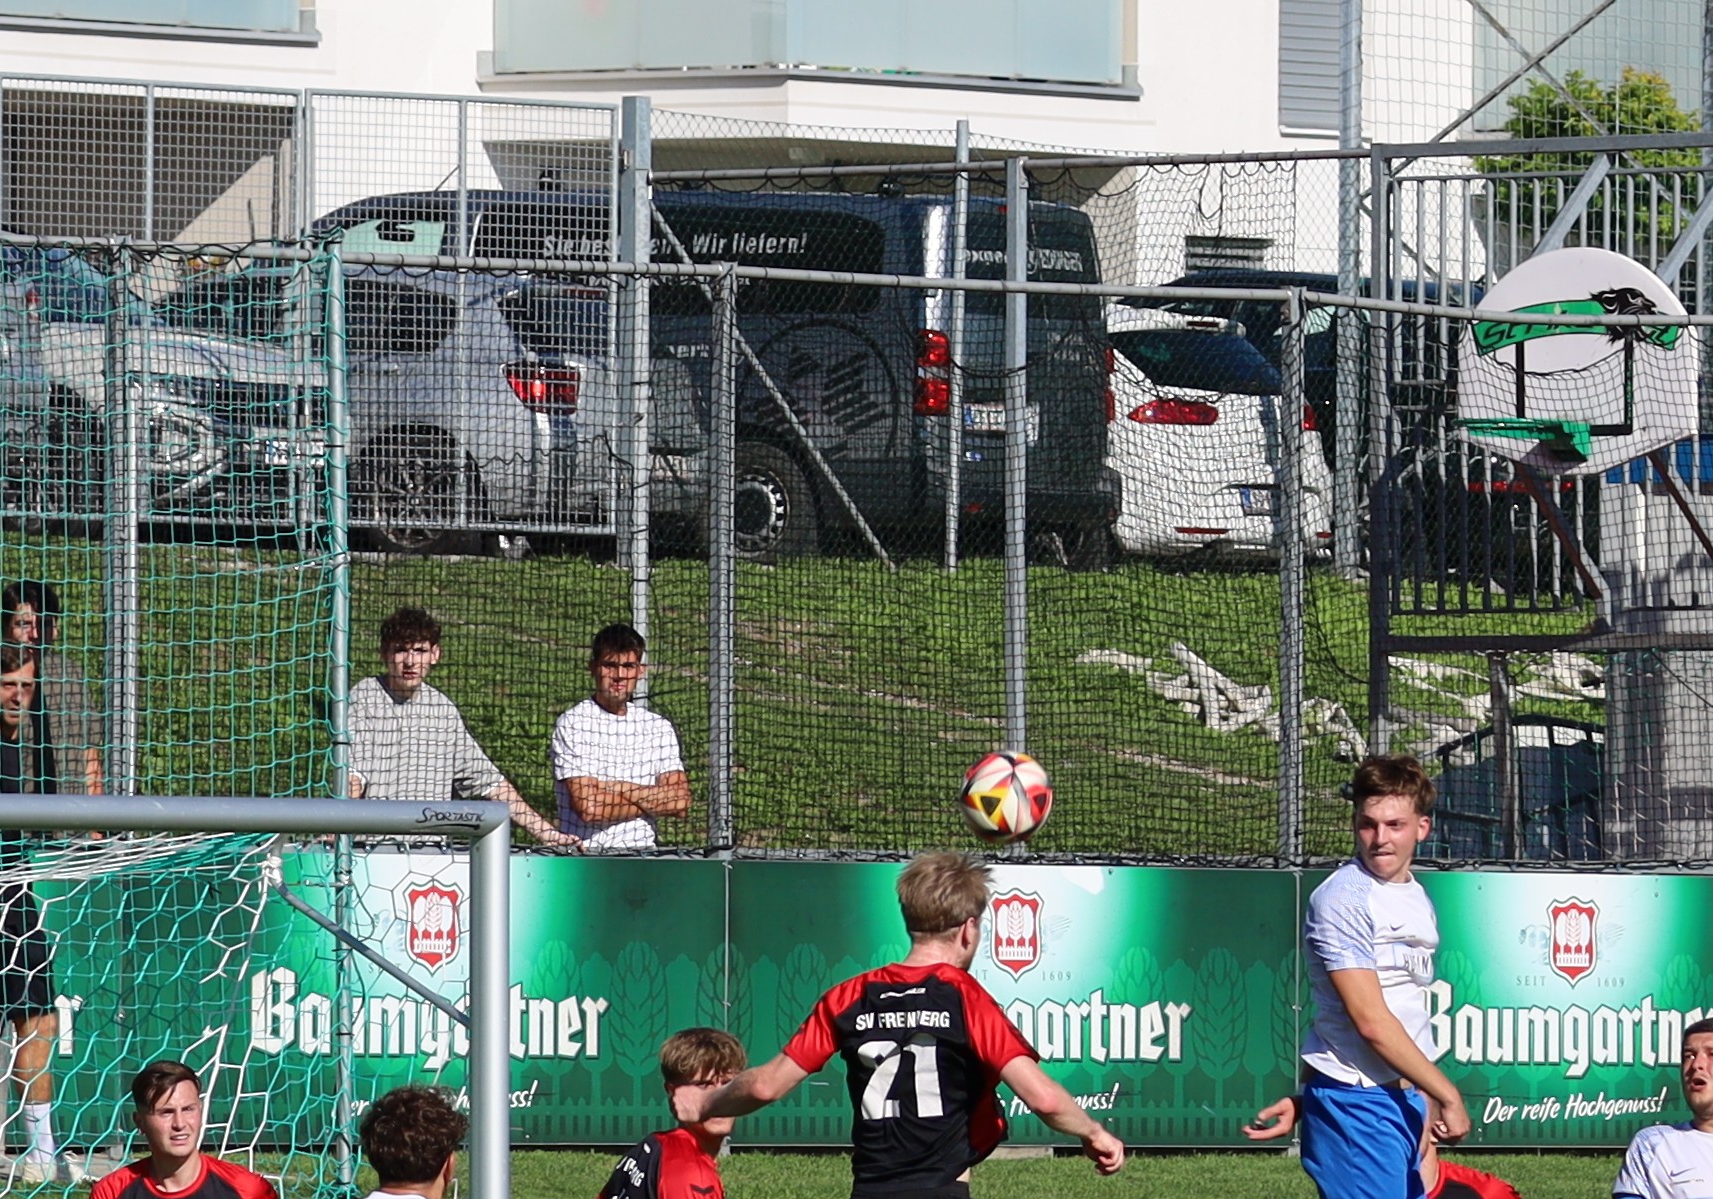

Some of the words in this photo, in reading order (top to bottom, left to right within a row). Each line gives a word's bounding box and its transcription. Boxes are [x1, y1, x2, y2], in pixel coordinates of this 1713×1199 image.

[692, 233, 726, 255] Wir
[1041, 970, 1072, 982] 1609
[1516, 975, 1546, 987] SEIT
[1597, 976, 1625, 988] 1609
[250, 966, 608, 1071] Baumgtner
[855, 1012, 875, 1031] SV
[857, 1033, 944, 1120] 21
[1483, 1096, 1518, 1125] Der
[1523, 1096, 1561, 1123] reife
[1565, 1086, 1667, 1123] Hochgenuss!
